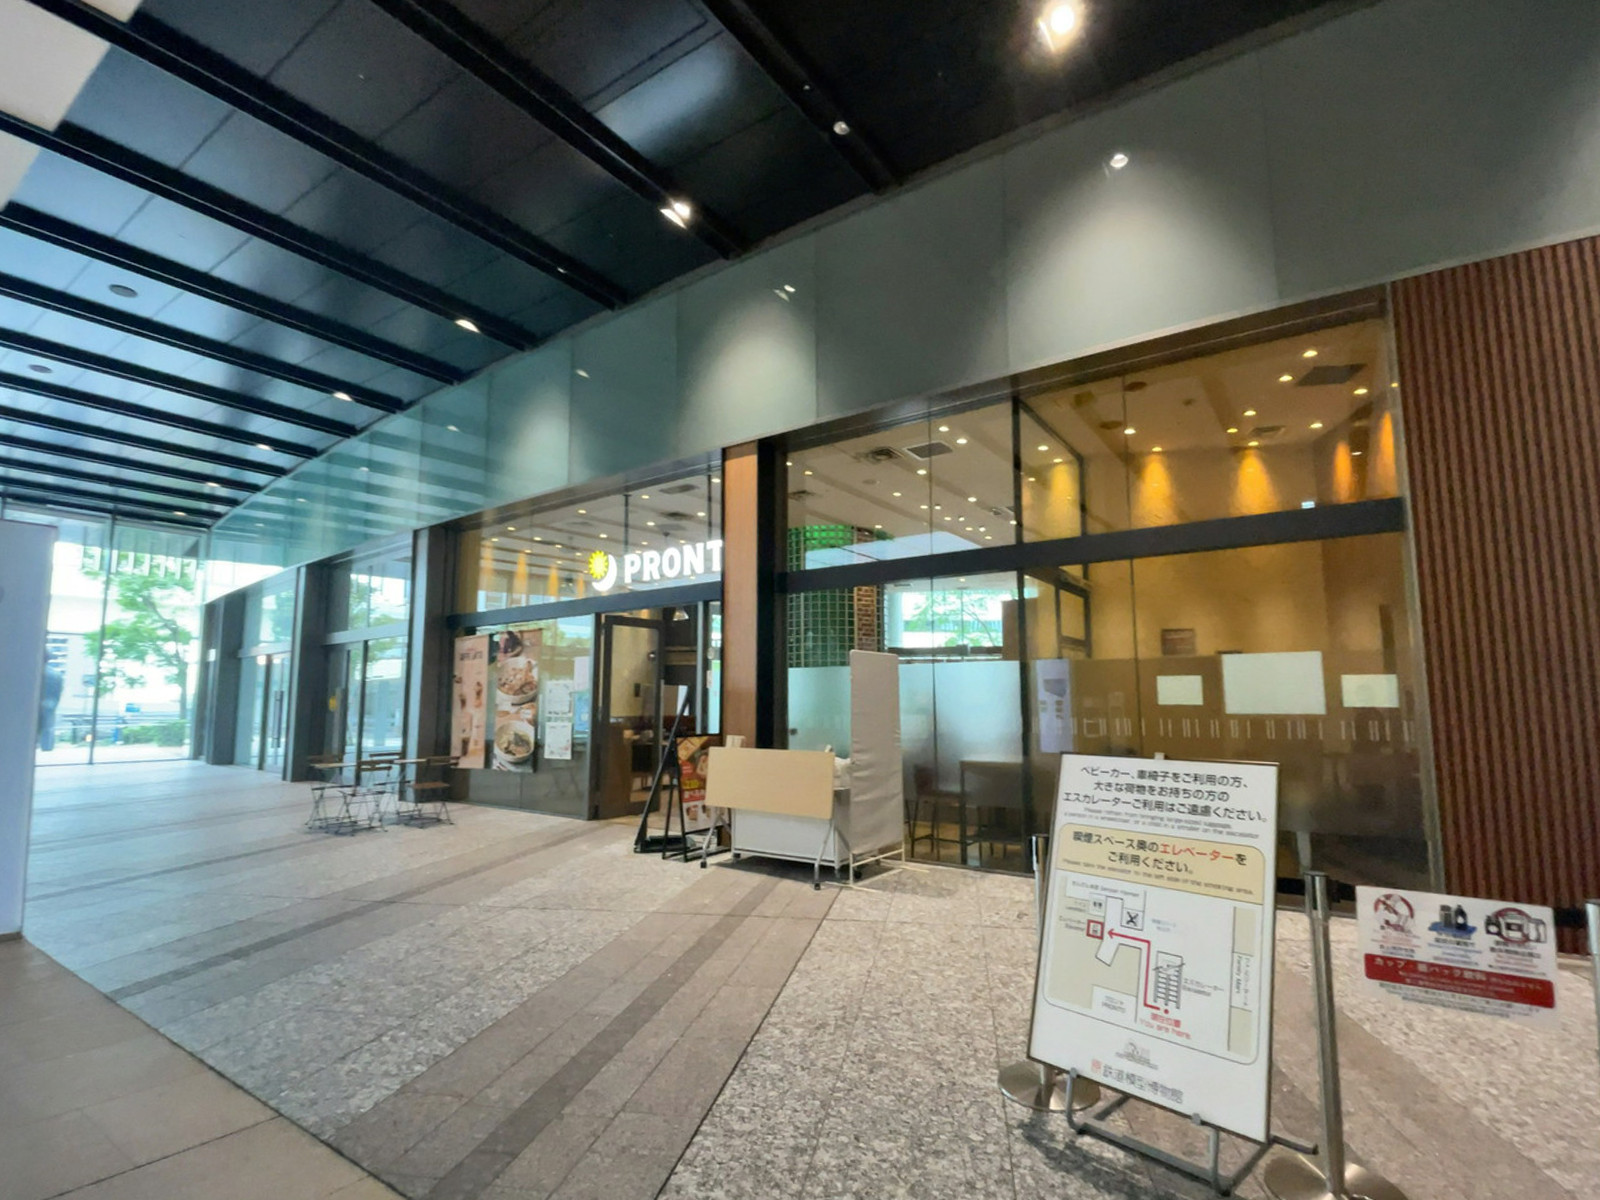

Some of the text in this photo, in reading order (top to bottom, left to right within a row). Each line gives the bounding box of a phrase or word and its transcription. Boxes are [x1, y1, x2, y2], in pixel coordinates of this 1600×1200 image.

[623, 539, 722, 584] PRONT
[1080, 766, 1248, 789] ベビーカー、車椅子をご利用の方、
[1093, 781, 1230, 802] 大きな荷物をお持ちの方の
[1063, 792, 1267, 823] エスカレーターご利用はご遠慮ください。
[1107, 852, 1193, 874] ご利用ください。
